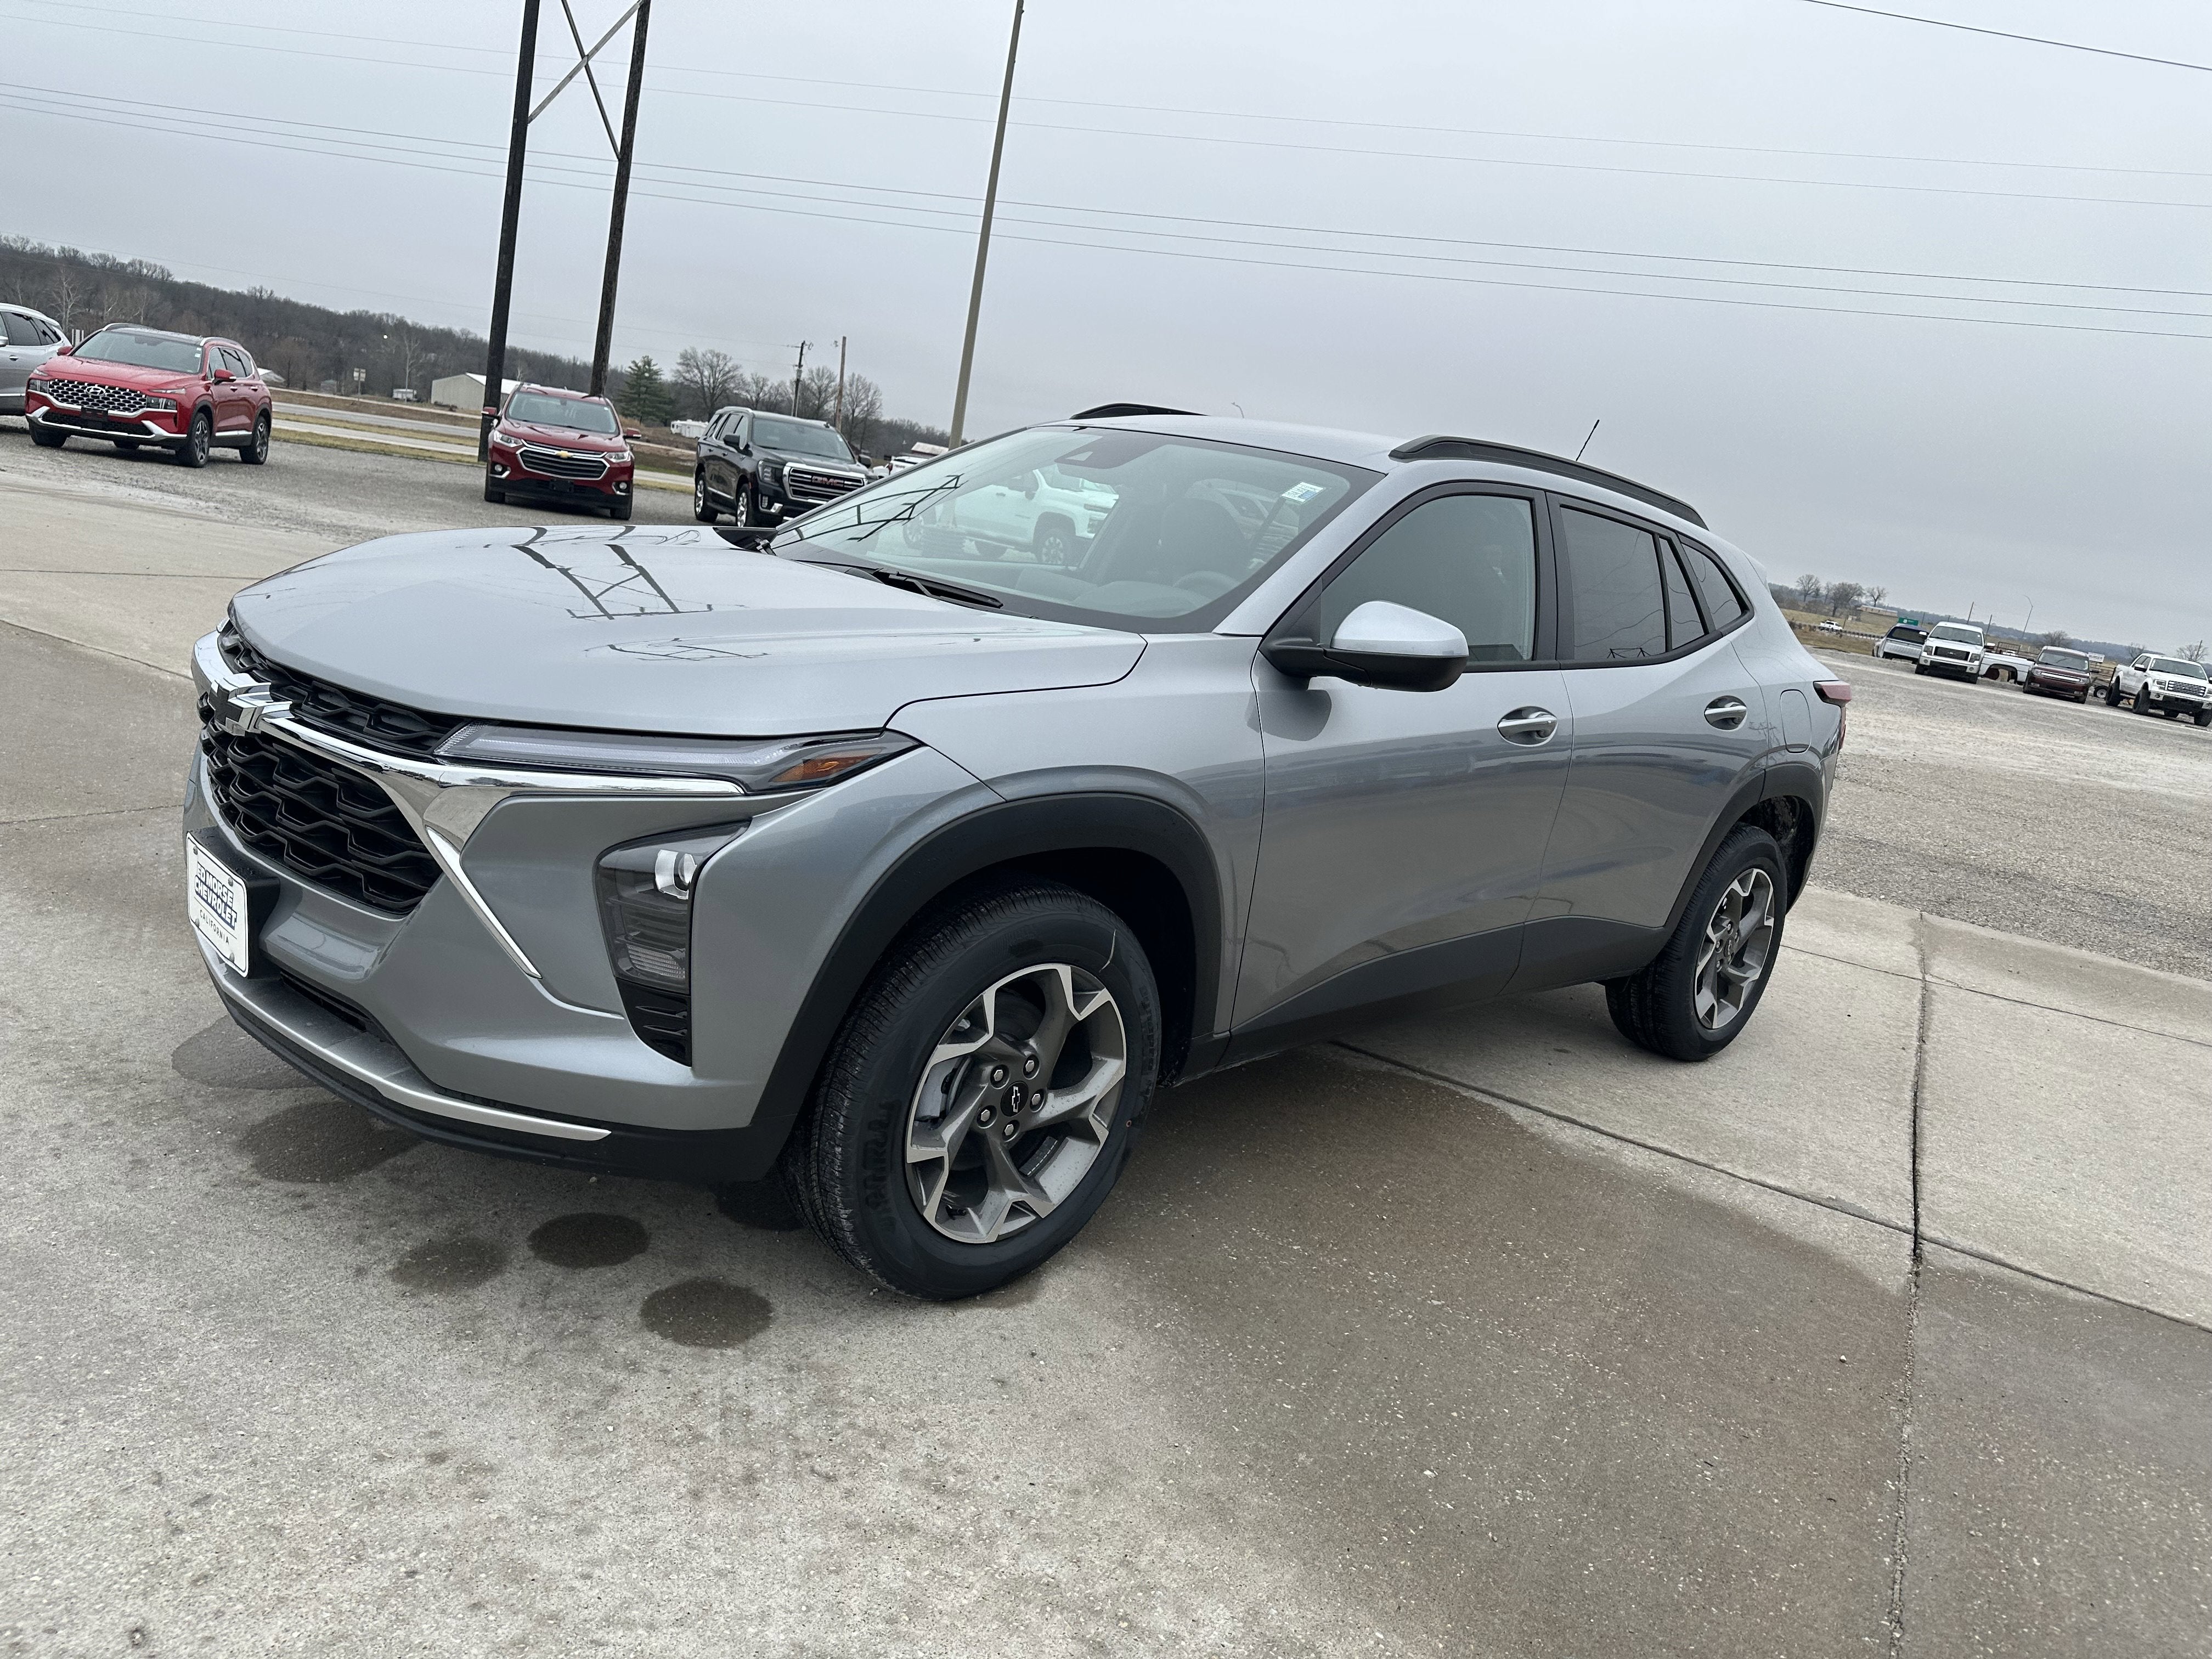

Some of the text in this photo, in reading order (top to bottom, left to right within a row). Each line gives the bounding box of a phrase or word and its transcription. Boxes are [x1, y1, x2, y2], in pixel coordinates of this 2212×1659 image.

[195, 874, 237, 930] CHEVROLET
[197, 861, 234, 908] ED MORSE
[200, 910, 229, 945] CALIFORNIA
